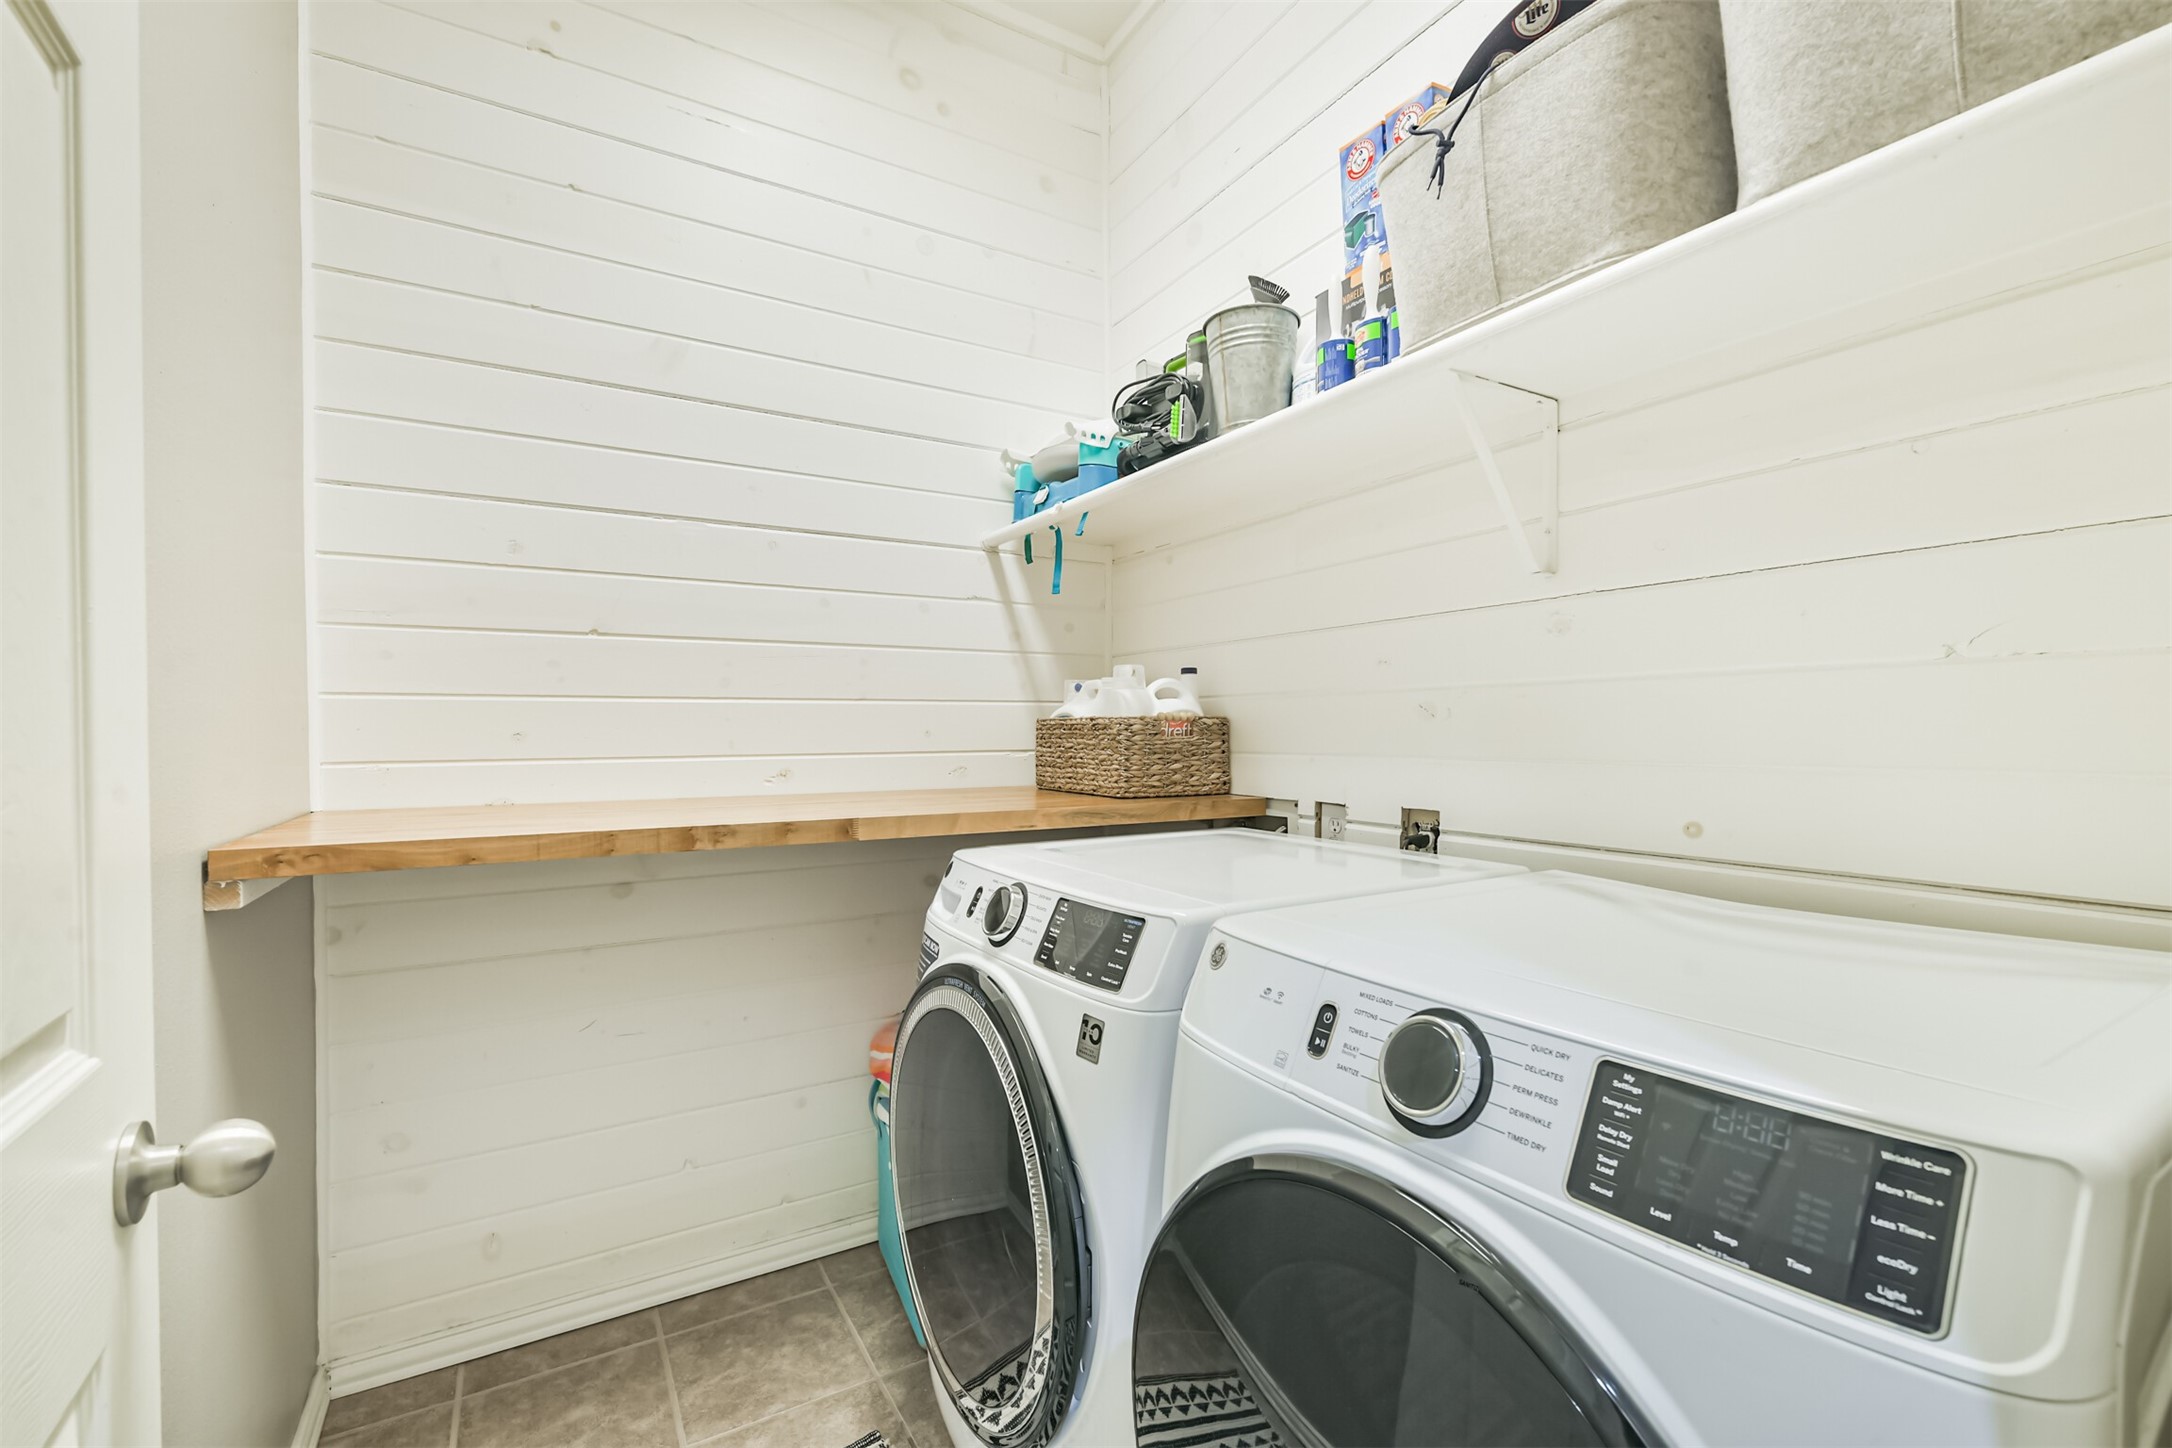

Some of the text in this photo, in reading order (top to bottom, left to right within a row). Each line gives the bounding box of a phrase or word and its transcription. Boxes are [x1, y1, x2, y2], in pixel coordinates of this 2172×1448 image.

[1525, 3, 1549, 25] Lite
[1342, 286, 1364, 304] NDHELD
[1160, 722, 1192, 738] dreft
[1359, 991, 1394, 1007] MIXED LOADS
[1354, 1008, 1379, 1021] COTTONS
[1348, 1026, 1369, 1039] TOWELS
[1530, 1043, 1571, 1062] QUICK DRY
[1336, 1063, 1360, 1077] SANITIZE
[1524, 1064, 1564, 1083] DELICATES
[1623, 1073, 1635, 1084] My
[1512, 1084, 1558, 1107] PERM PRESS
[1612, 1079, 1643, 1095] Settings
[1602, 1096, 1642, 1115] Damp Alert
[1509, 1107, 1552, 1130] DEWRINKLE
[1598, 1123, 1633, 1142] Delay Dry
[1506, 1131, 1546, 1153] TIMED DRY
[1596, 1163, 1615, 1176] Load
[1597, 1154, 1618, 1168] Small
[1880, 1150, 1922, 1169] Wrinkle
[1923, 1161, 1952, 1176] Care
[1589, 1182, 1614, 1198] Sound
[1874, 1181, 1905, 1198] More
[1904, 1189, 1935, 1206] Time
[1650, 1206, 1672, 1222] Level
[1870, 1214, 1897, 1231] Less
[1897, 1222, 1927, 1239] Time
[1713, 1229, 1739, 1247] Temp
[1785, 1256, 1813, 1275] Time
[1877, 1284, 1908, 1303] Light
